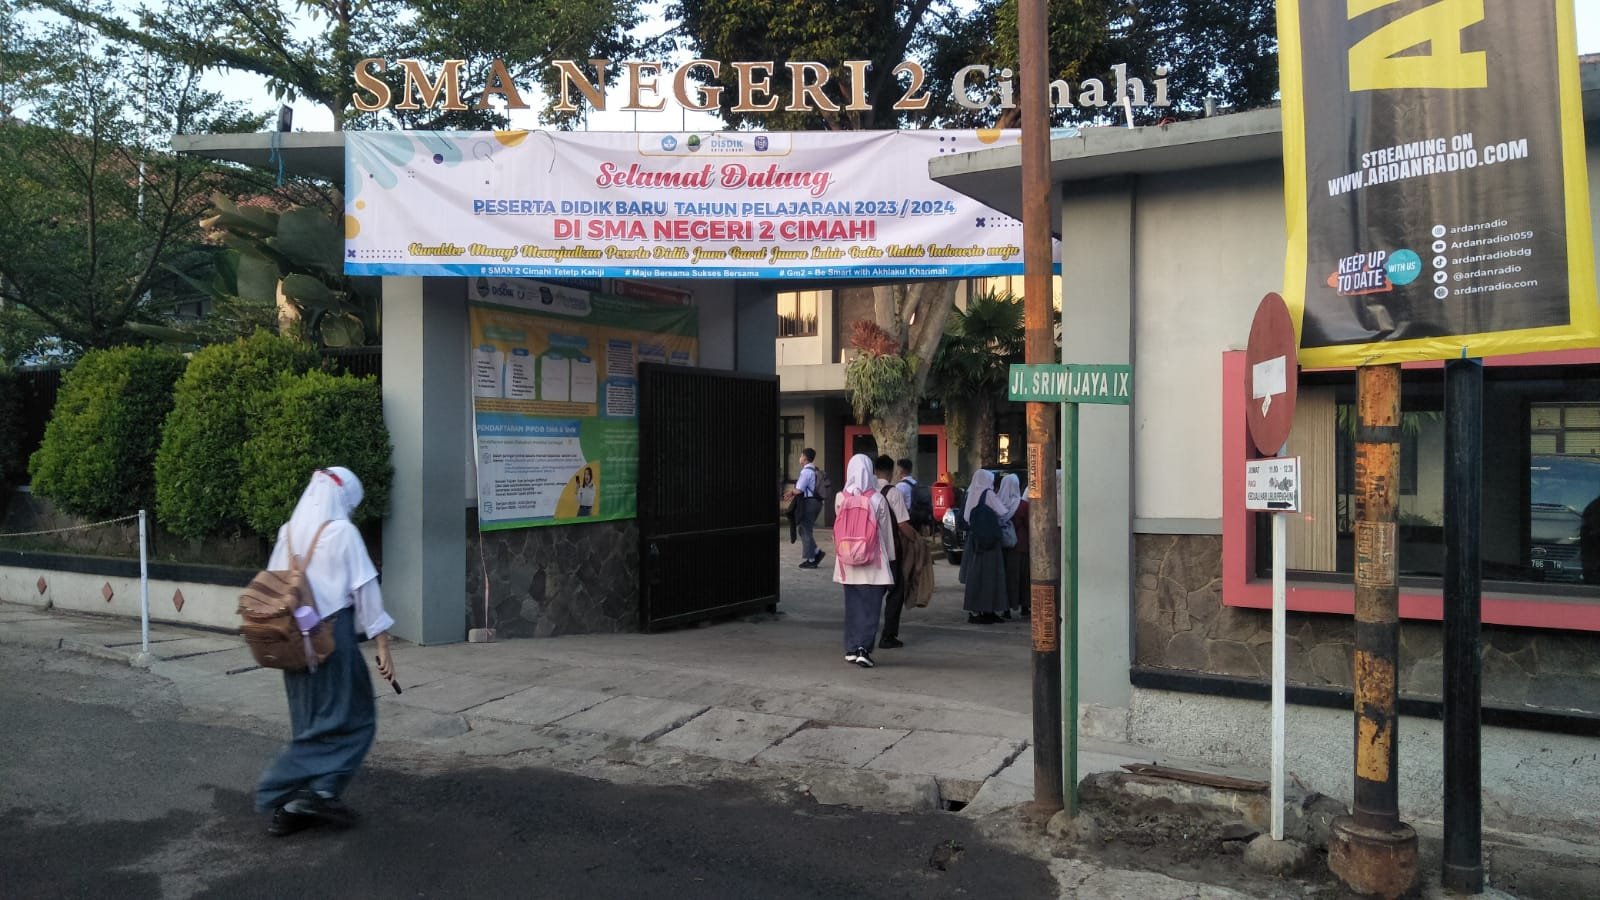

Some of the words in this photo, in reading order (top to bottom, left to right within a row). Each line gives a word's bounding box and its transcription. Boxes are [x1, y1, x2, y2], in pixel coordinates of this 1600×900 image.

[352, 57, 531, 113] SMA
[551, 58, 873, 115] NEGERI
[892, 60, 931, 111] 2
[1361, 138, 1446, 170] STREAMING
[1451, 132, 1473, 155] ON
[1327, 138, 1529, 197] WWW.ARDANRADIO.COM
[596, 162, 714, 189] Selamat
[720, 162, 833, 198] Datang
[474, 199, 556, 216] PESERTA
[560, 201, 613, 217] DIDIK
[615, 201, 669, 217] BARU
[673, 201, 737, 217] TAHUN
[742, 201, 851, 217] PELAJARAN
[554, 218, 581, 240] DI
[587, 219, 648, 241] SMA
[653, 220, 753, 242] NEGERI
[758, 220, 776, 242] 2
[780, 219, 878, 242] CIMAHI
[1450, 219, 1509, 235] ardanradio
[1450, 231, 1534, 250] Ardanradio1059
[409, 242, 465, 257] Karakter
[468, 243, 518, 262] Masagi
[520, 244, 602, 263] Mewujudkan
[605, 244, 650, 259] Peserta
[653, 245, 689, 259] Didik
[691, 245, 727, 265] Jawa
[728, 246, 767, 260] Barat
[769, 245, 809, 265] Juara
[811, 245, 846, 260] Lahir
[848, 245, 883, 259] Batin
[886, 243, 925, 258] Untuk
[927, 243, 985, 258] Indonesia
[987, 244, 1020, 260] maju
[1338, 253, 1366, 275] KEEP
[1368, 249, 1387, 269] UP
[1451, 247, 1533, 266] ardanradiobdg
[488, 266, 513, 275] SMAN
[515, 266, 521, 275] 2
[523, 266, 551, 275] Cimahi
[633, 268, 652, 278] Maju
[655, 268, 690, 278] Bersama
[692, 269, 722, 278] Sukses
[724, 269, 760, 278] Bersama
[815, 268, 826, 277] Be
[828, 267, 853, 277] Smart
[855, 267, 872, 277] with
[910, 265, 949, 275] Kharimah
[1388, 262, 1406, 274] WITH
[1406, 260, 1417, 272] US
[1453, 264, 1522, 284] @ardanradio
[1337, 273, 1353, 293] TO
[1353, 269, 1384, 291] DATE
[1453, 279, 1538, 297] ardanradio.com
[1032, 371, 1108, 397] SRIWIJAYA
[1113, 372, 1128, 397] IX
